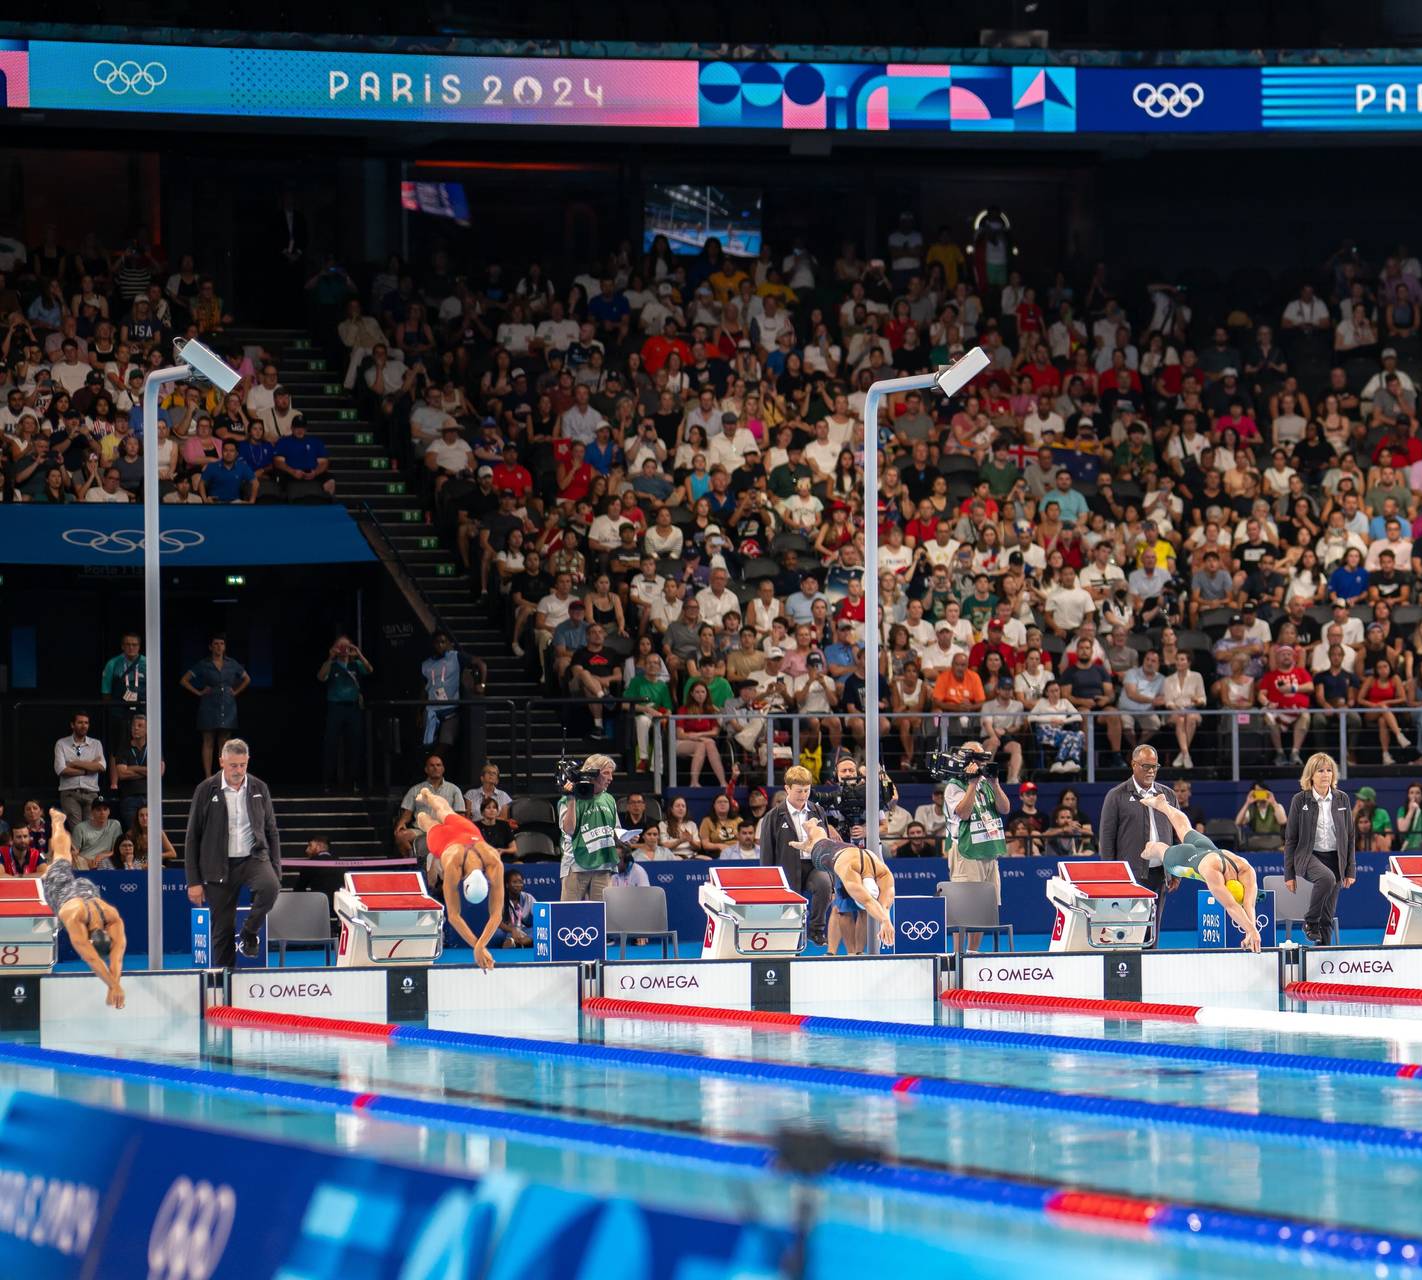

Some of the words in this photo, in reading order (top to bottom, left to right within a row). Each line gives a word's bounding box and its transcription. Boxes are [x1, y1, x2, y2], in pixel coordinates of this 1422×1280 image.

[483, 75, 603, 106] 2024
[1056, 918, 1063, 937] 5
[1390, 912, 1396, 930] 4
[707, 923, 713, 943] 6
[1203, 928, 1220, 943] 2024
[537, 942, 549, 956] 2024
[751, 932, 768, 951] 6
[1, 946, 20, 965] 8
[997, 968, 1054, 981] OMEGA
[1339, 961, 1393, 974] OMEGA
[269, 983, 333, 998] OMEGA
[640, 976, 699, 989] OMEGA
